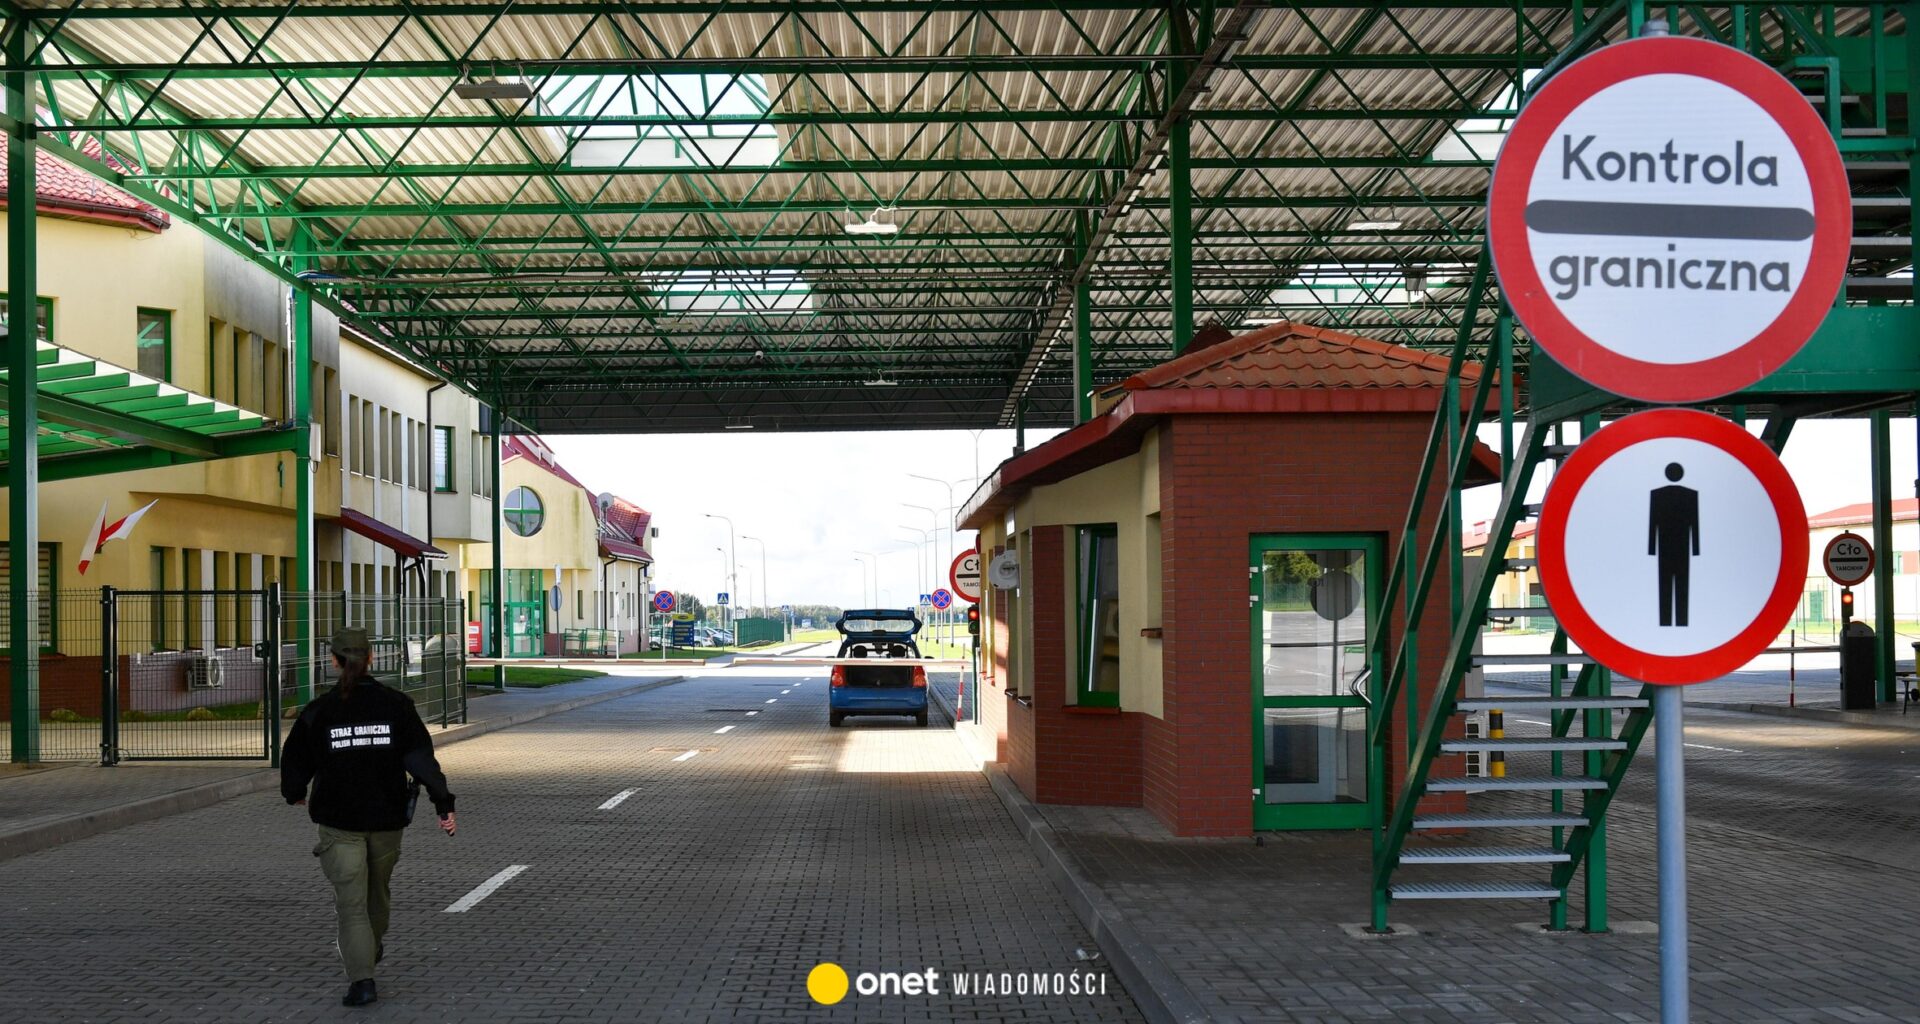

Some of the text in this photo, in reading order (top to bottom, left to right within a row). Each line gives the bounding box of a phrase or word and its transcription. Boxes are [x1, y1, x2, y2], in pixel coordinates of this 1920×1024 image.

[1562, 134, 1778, 187] Kontrola
[1549, 243, 1791, 301] graniczna
[1837, 543, 1862, 556] Cło
[963, 559, 980, 571] Cł
[353, 724, 391, 736] GRANICZNA
[331, 736, 391, 749] POLISH BORDER GUARD
